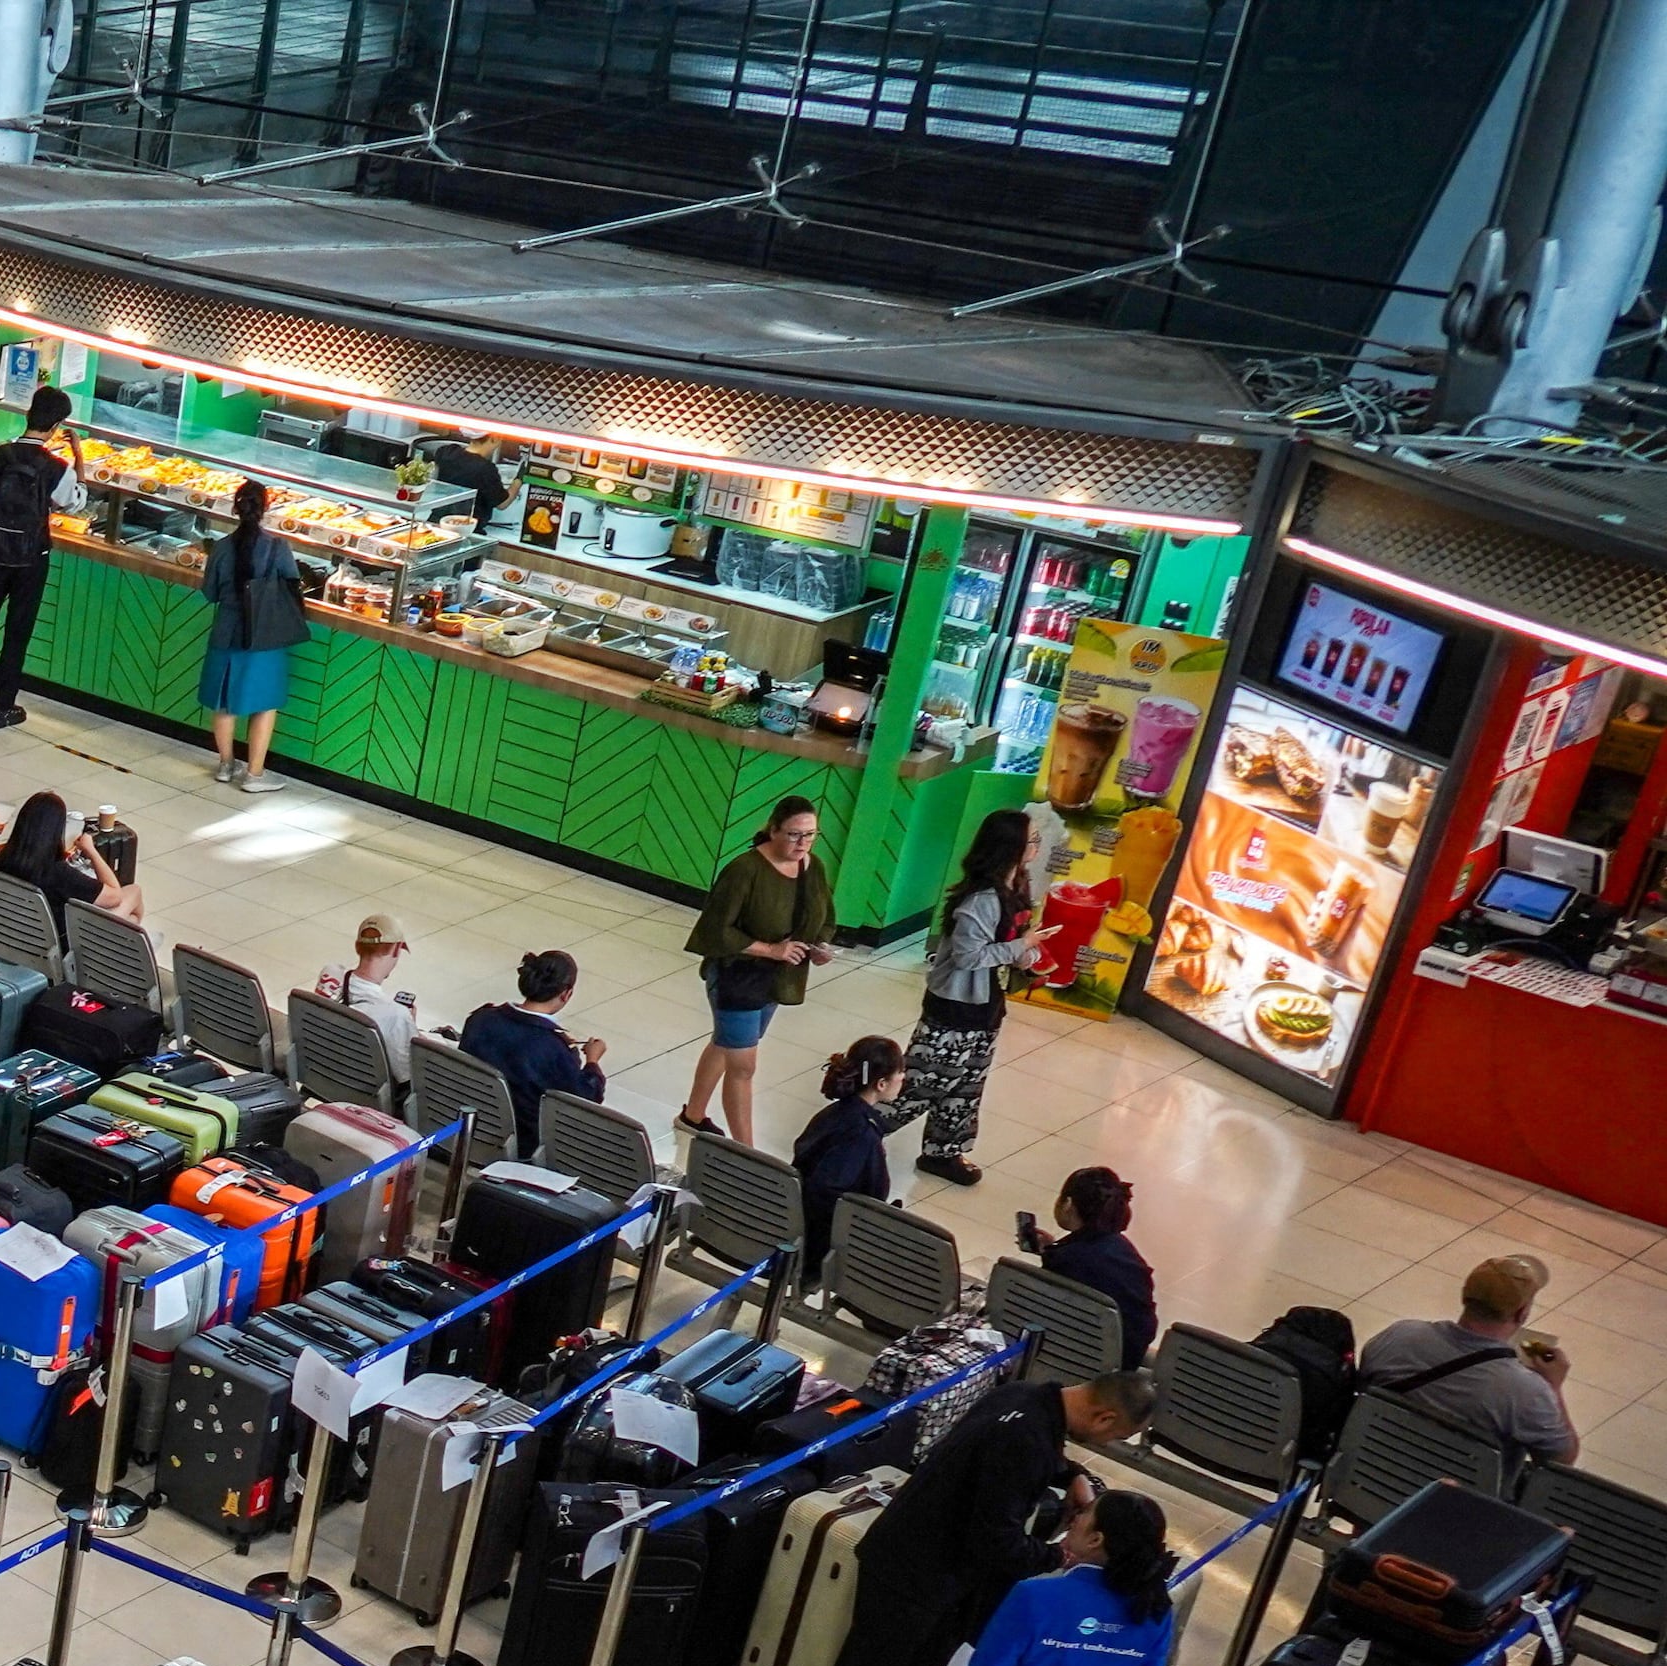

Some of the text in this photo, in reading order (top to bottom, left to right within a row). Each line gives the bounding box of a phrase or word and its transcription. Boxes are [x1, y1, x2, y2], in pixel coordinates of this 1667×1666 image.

[350, 1170, 368, 1186] AOT
[207, 1243, 224, 1258] AOT
[434, 1311, 453, 1328] AOT
[805, 1440, 826, 1456] AOT
[19, 1543, 42, 1561] AOT
[1041, 1637, 1146, 1657] Airport Ambassador
